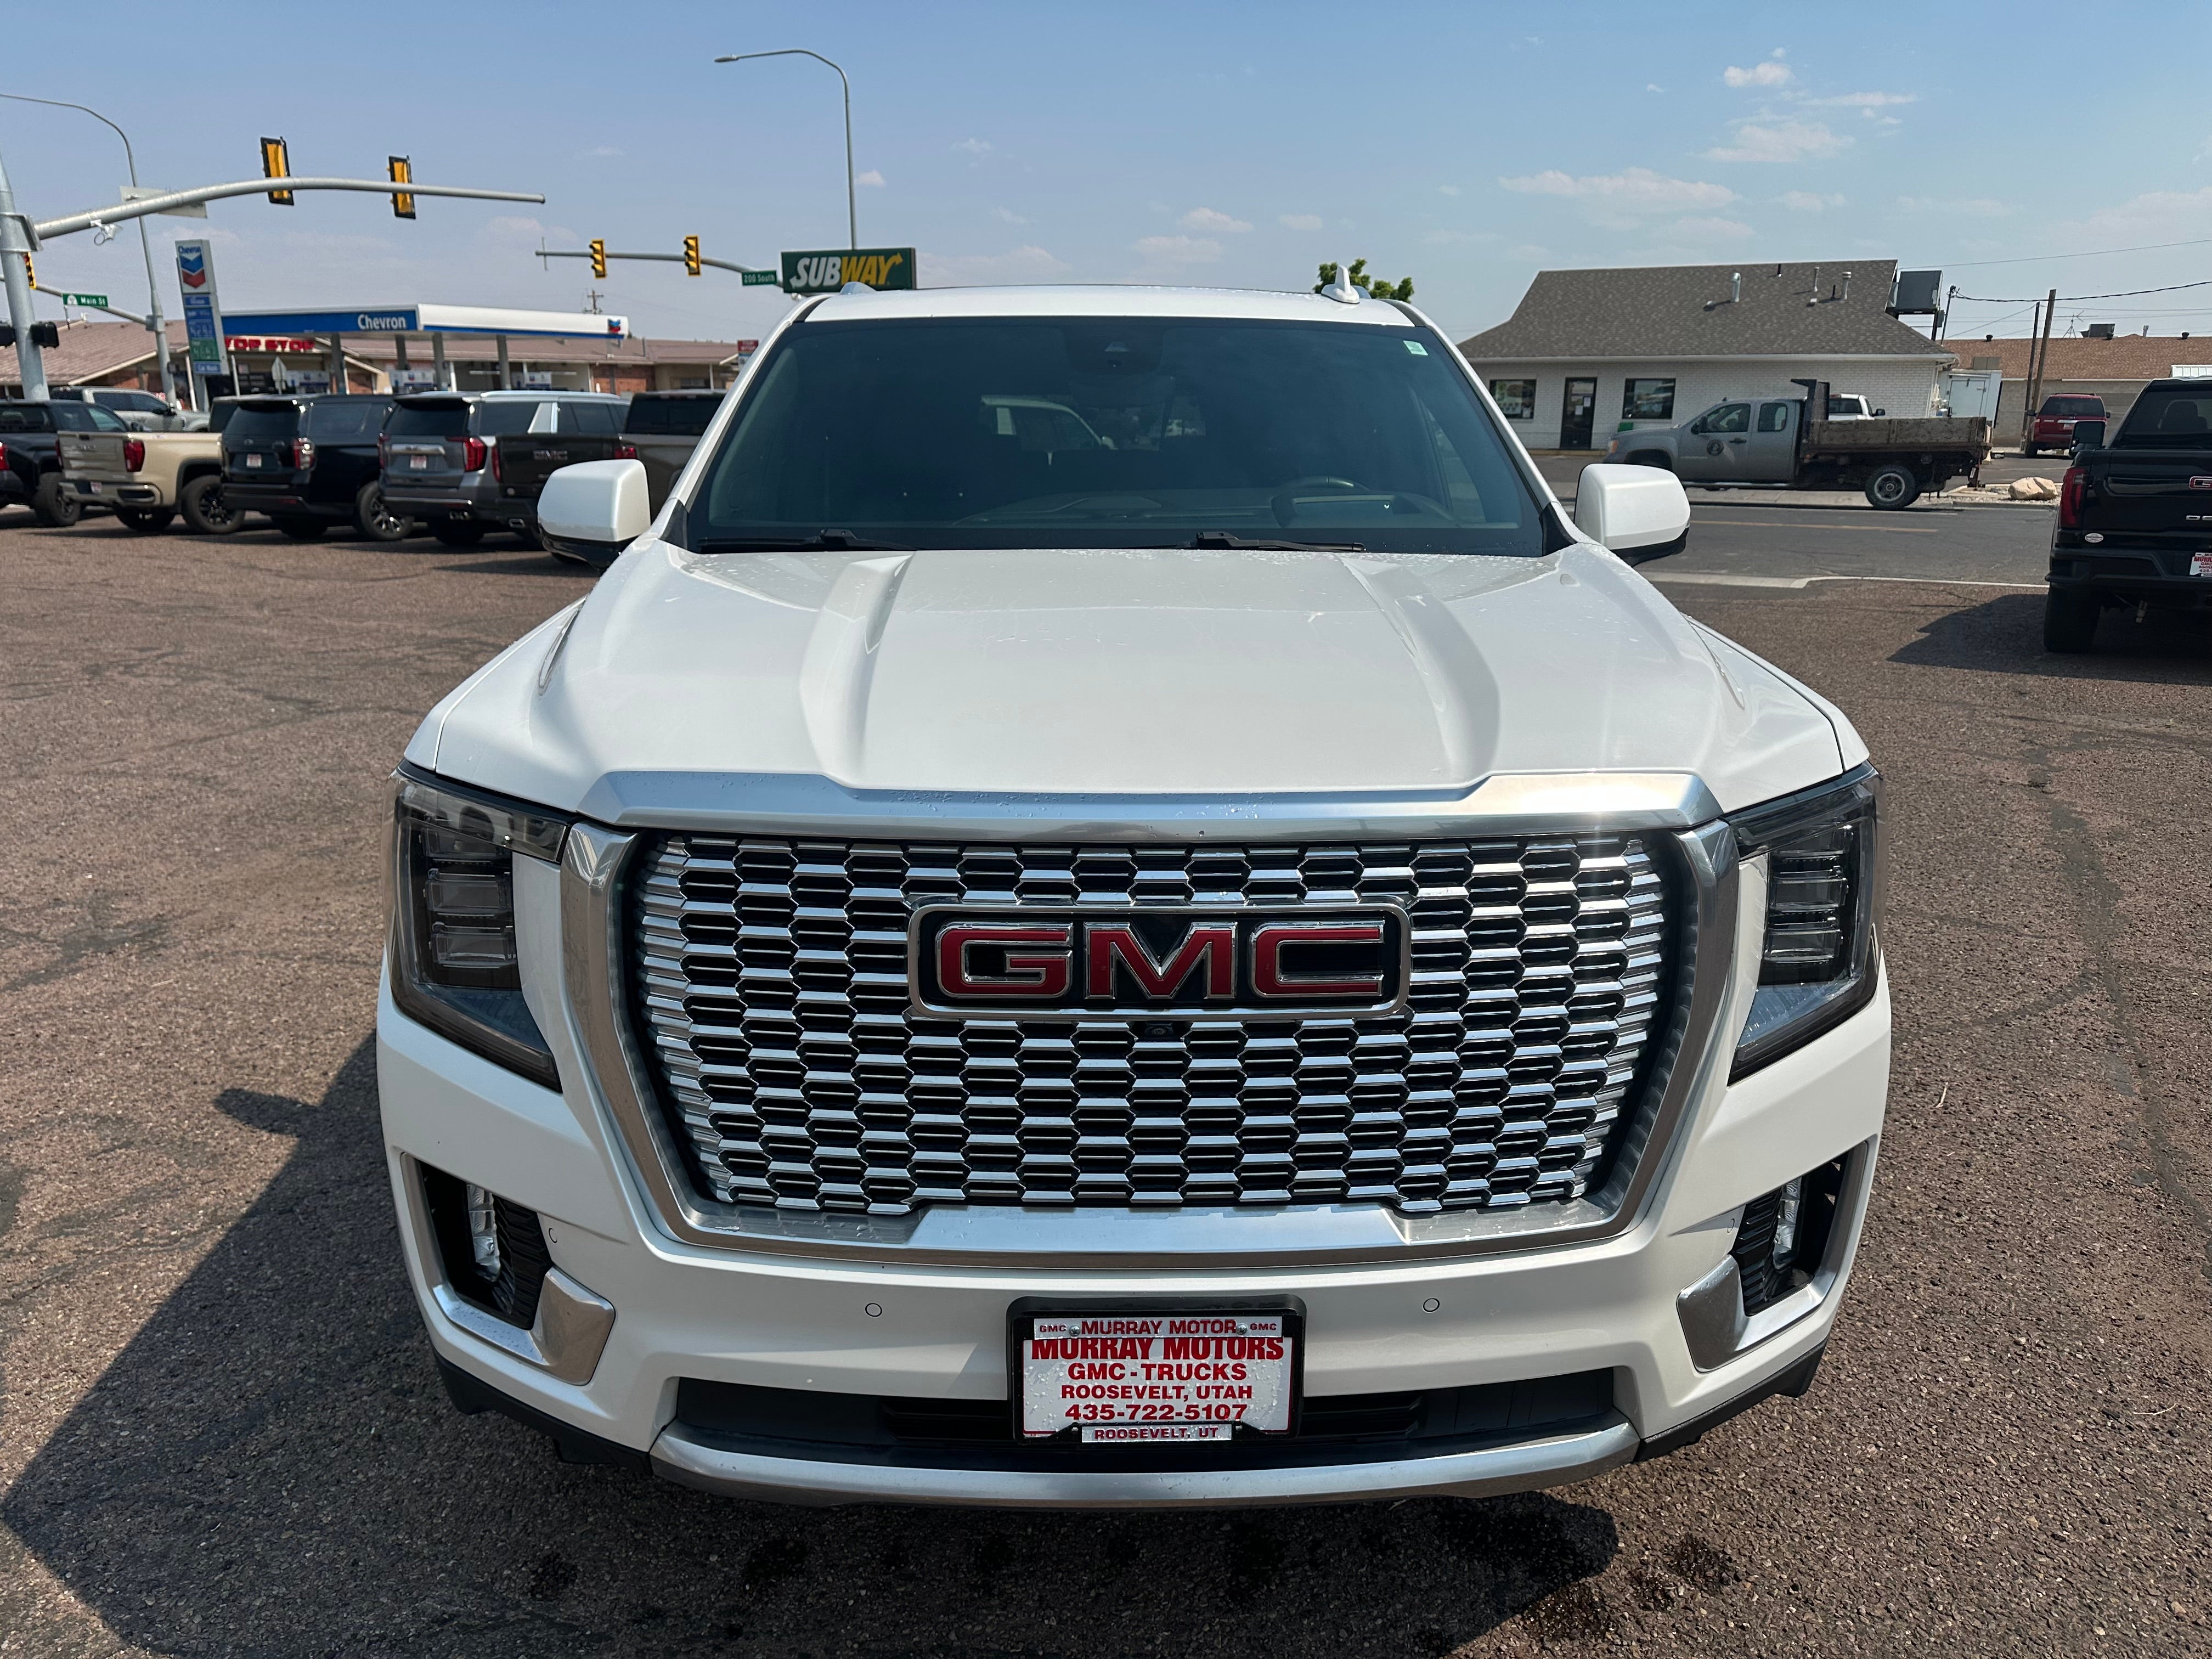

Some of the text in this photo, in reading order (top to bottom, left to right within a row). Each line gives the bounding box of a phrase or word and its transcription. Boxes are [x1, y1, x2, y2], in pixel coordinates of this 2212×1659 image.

[789, 252, 904, 288] SUBWAY
[744, 274, 775, 284] 200 South
[81, 296, 97, 304] Main
[98, 297, 106, 306] St
[358, 314, 406, 329] Chevron
[265, 339, 315, 350] STOP
[935, 920, 1385, 1000] GMC
[1040, 1324, 1066, 1333] GMC
[1081, 1320, 1163, 1334] MURRAY
[1169, 1319, 1237, 1334] MOTOR
[1031, 1338, 1284, 1360] MURRAY MOTORS
[1062, 1385, 1252, 1402] ROOSEVELT, UTAH
[1065, 1404, 1248, 1420] 435-722-5107
[1094, 1427, 1218, 1440] ROOSEVELT, UT
